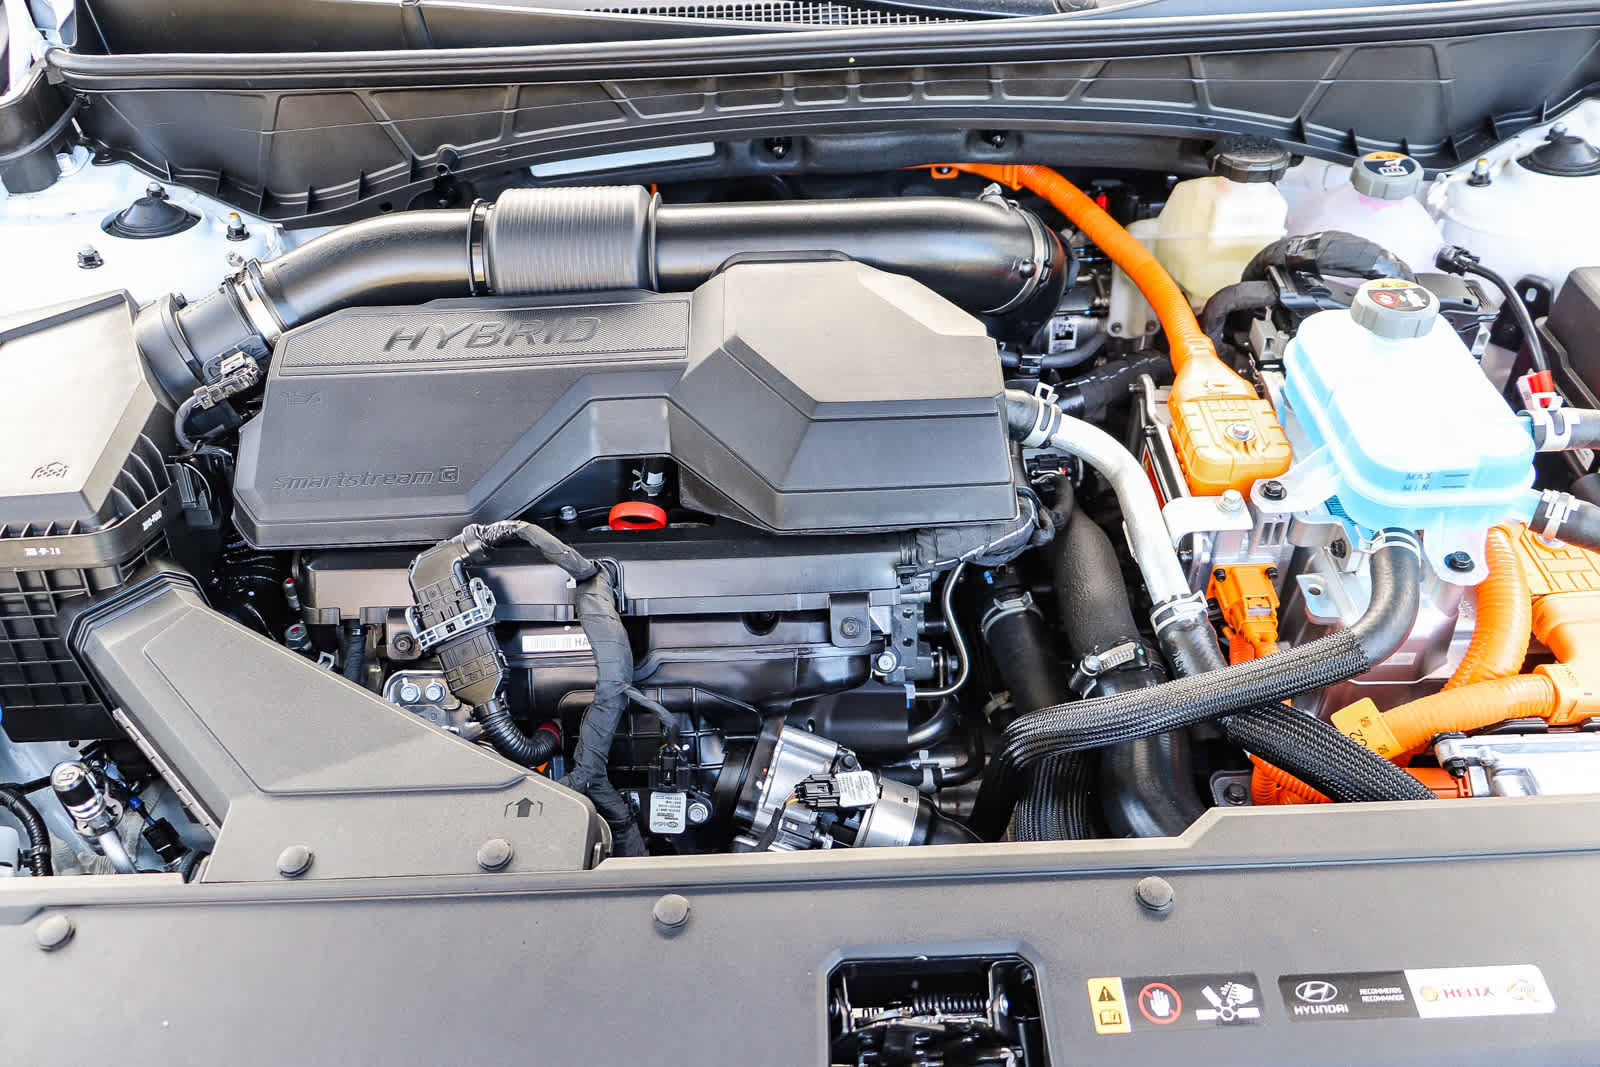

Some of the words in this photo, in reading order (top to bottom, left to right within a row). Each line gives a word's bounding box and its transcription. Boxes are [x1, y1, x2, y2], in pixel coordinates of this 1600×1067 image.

[383, 316, 601, 352] HYBRID
[1405, 471, 1432, 481] MAX
[1401, 483, 1430, 492] MIN
[1293, 1004, 1349, 1015] HYUNDAI
